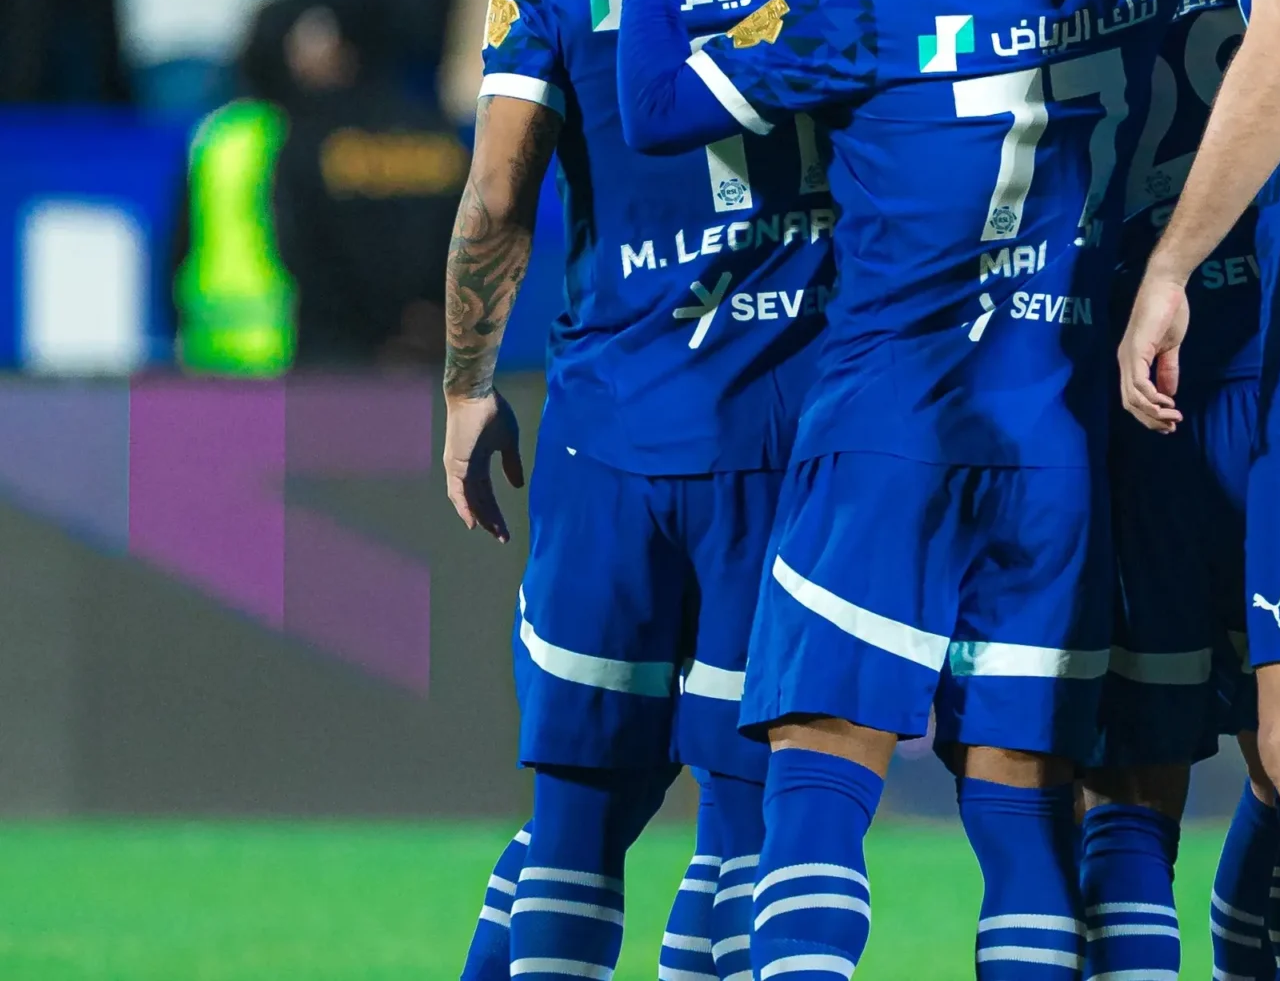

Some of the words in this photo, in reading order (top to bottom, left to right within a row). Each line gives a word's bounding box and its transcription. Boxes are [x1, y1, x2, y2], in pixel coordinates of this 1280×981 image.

[952, 46, 1131, 242] 77
[674, 208, 836, 265] LEONAR
[1009, 290, 1093, 325] SEVEN
